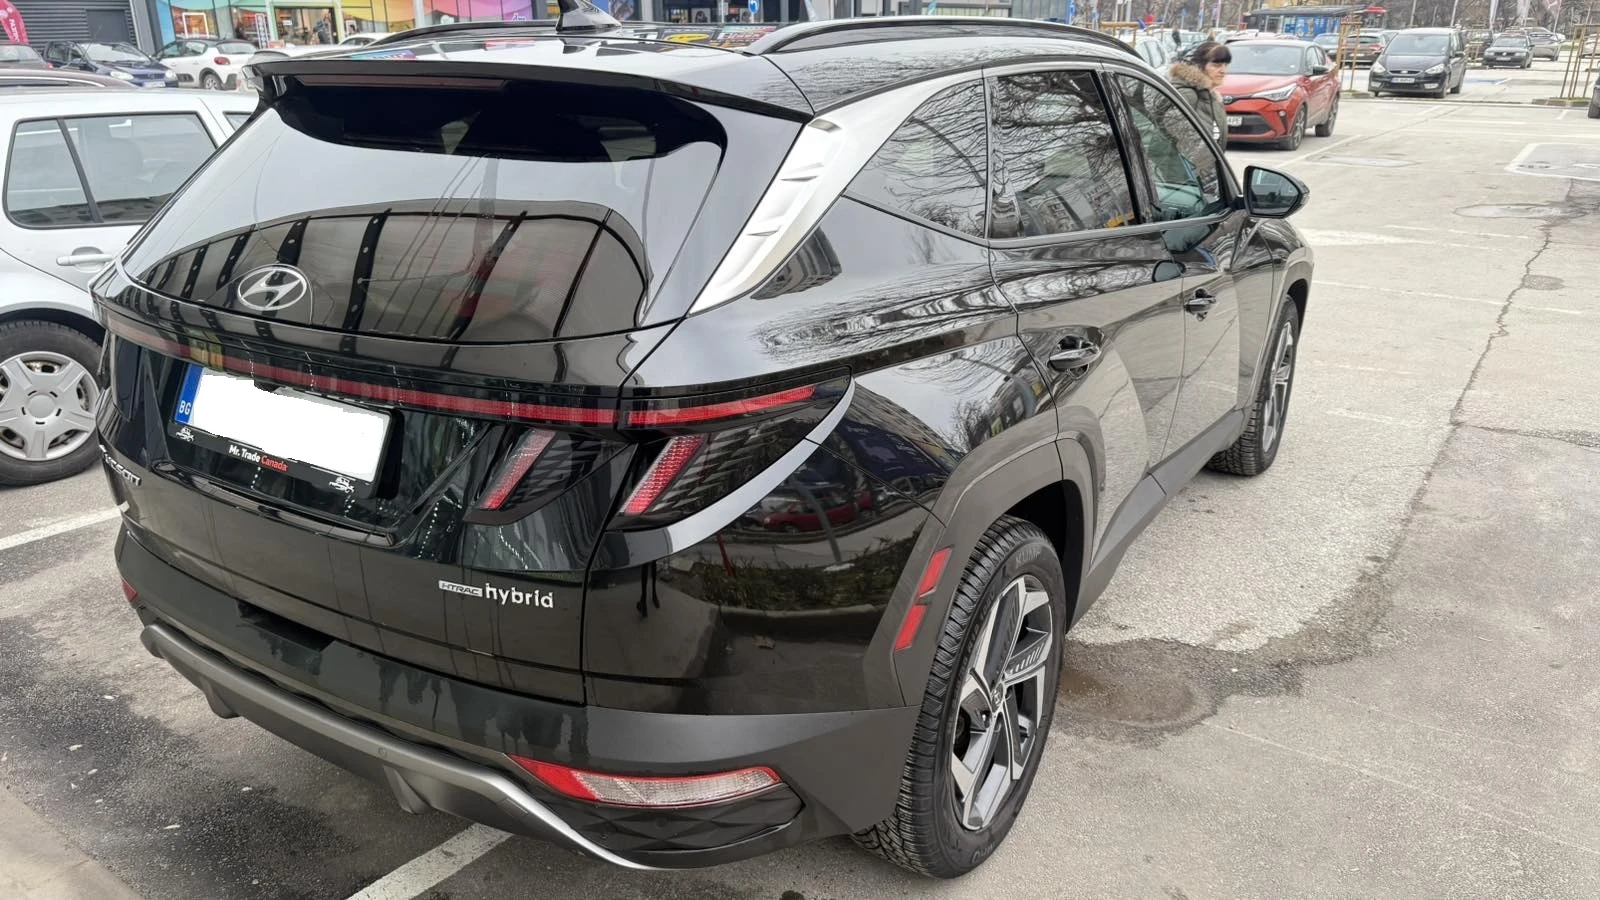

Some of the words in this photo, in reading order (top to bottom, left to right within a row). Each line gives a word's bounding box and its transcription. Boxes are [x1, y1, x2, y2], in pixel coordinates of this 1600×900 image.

[179, 400, 192, 415] BG
[229, 444, 240, 456] Mr.
[241, 447, 261, 463] Trade
[261, 455, 289, 471] Canada
[440, 581, 481, 596] HTRAC
[485, 582, 554, 608] hybrid
